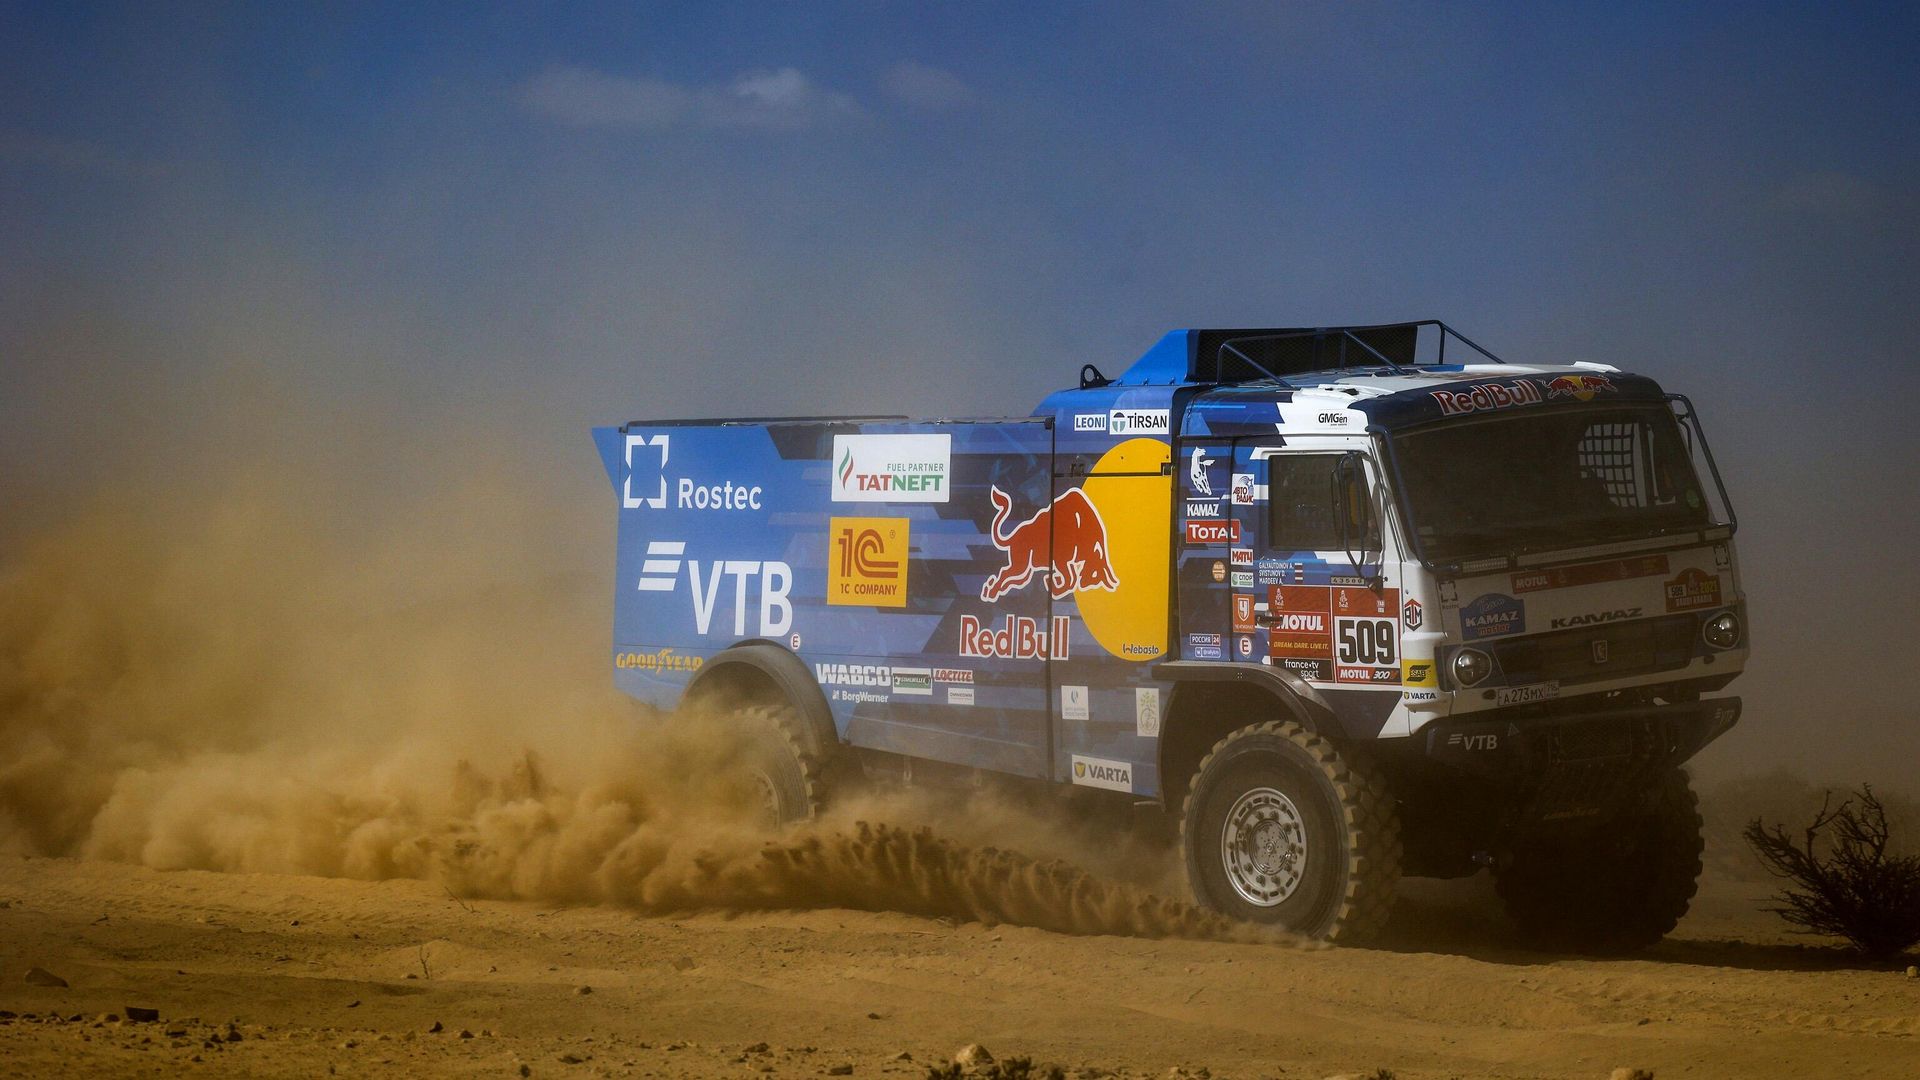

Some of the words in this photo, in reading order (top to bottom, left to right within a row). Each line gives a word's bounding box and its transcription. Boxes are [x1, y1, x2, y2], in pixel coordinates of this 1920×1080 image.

[1075, 416, 1105, 429] LEONI
[887, 463, 906, 472] FUEL
[908, 463, 944, 472] PARTNER
[856, 474, 944, 492] TATNEFT
[678, 478, 762, 510] Rostec
[1187, 503, 1220, 517] KAMAZ
[1516, 574, 1548, 589] MOTUL
[1700, 580, 1718, 593] 2021
[840, 584, 850, 595] 1C
[854, 584, 898, 596] COMPANY
[688, 560, 793, 637] VTB
[1276, 614, 1324, 631] MOTUL
[1466, 610, 1519, 627] KAMAZ
[1551, 607, 1642, 629] KAMAZ
[1480, 623, 1510, 636] master
[793, 635, 799, 648] E
[1241, 640, 1249, 653] E
[1273, 641, 1293, 649] DREAM.
[1310, 642, 1322, 650] LIVE
[1339, 620, 1395, 665] 509
[1122, 643, 1159, 655] Webasto
[815, 663, 891, 687] WABCO
[934, 669, 974, 683] LOCTITE
[1301, 669, 1320, 678] sport
[1340, 669, 1370, 680] MOTUL
[842, 690, 889, 704] BorgWarner
[1411, 692, 1436, 700] VARTA
[1463, 734, 1498, 751] VTB
[1088, 764, 1130, 785] VARTA
